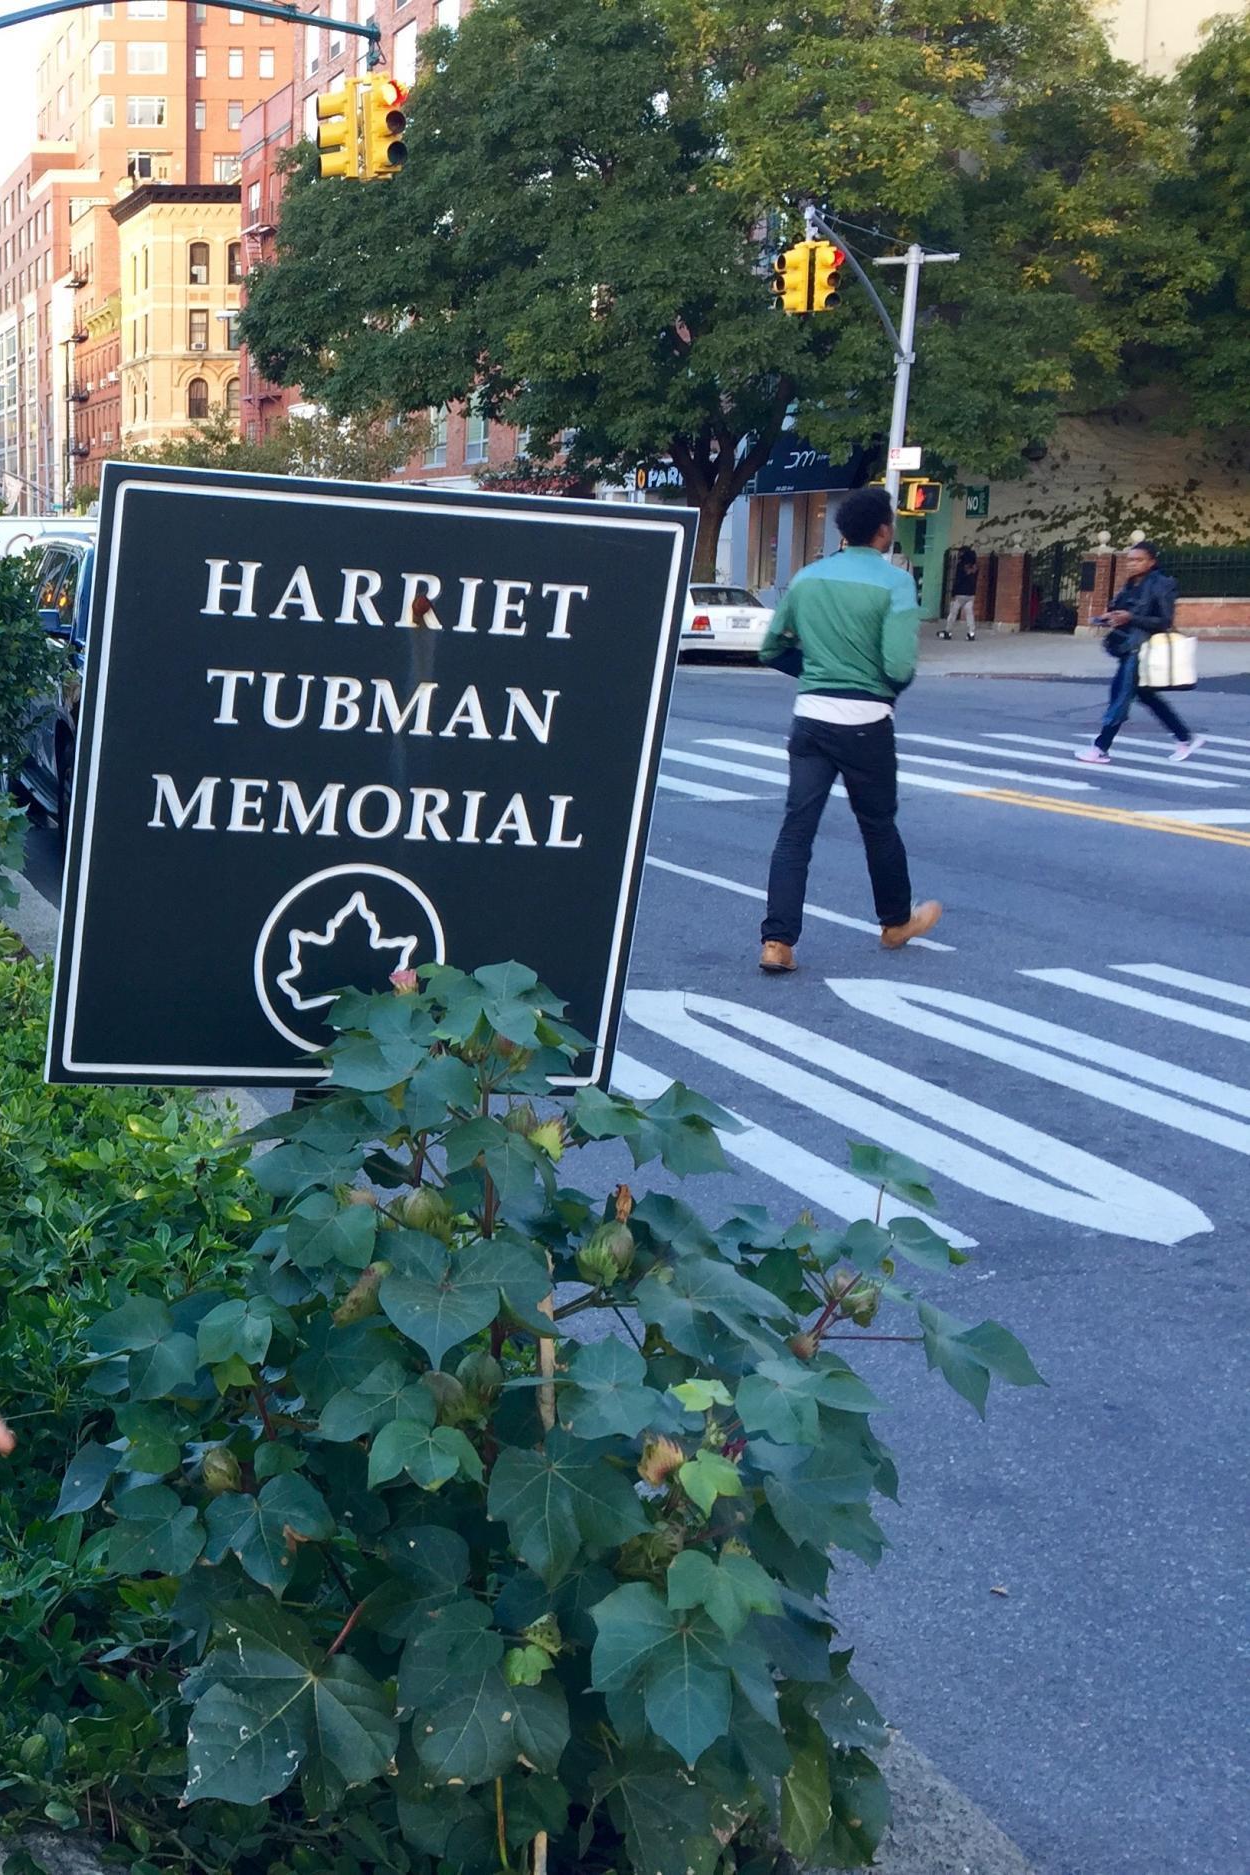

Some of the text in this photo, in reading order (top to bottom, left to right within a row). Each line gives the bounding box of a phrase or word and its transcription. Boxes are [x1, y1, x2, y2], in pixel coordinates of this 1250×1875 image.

[967, 496, 979, 511] NO
[199, 558, 589, 640] HARRIET
[206, 668, 561, 745] TUBMAN
[147, 773, 583, 850] MEMORIAL
